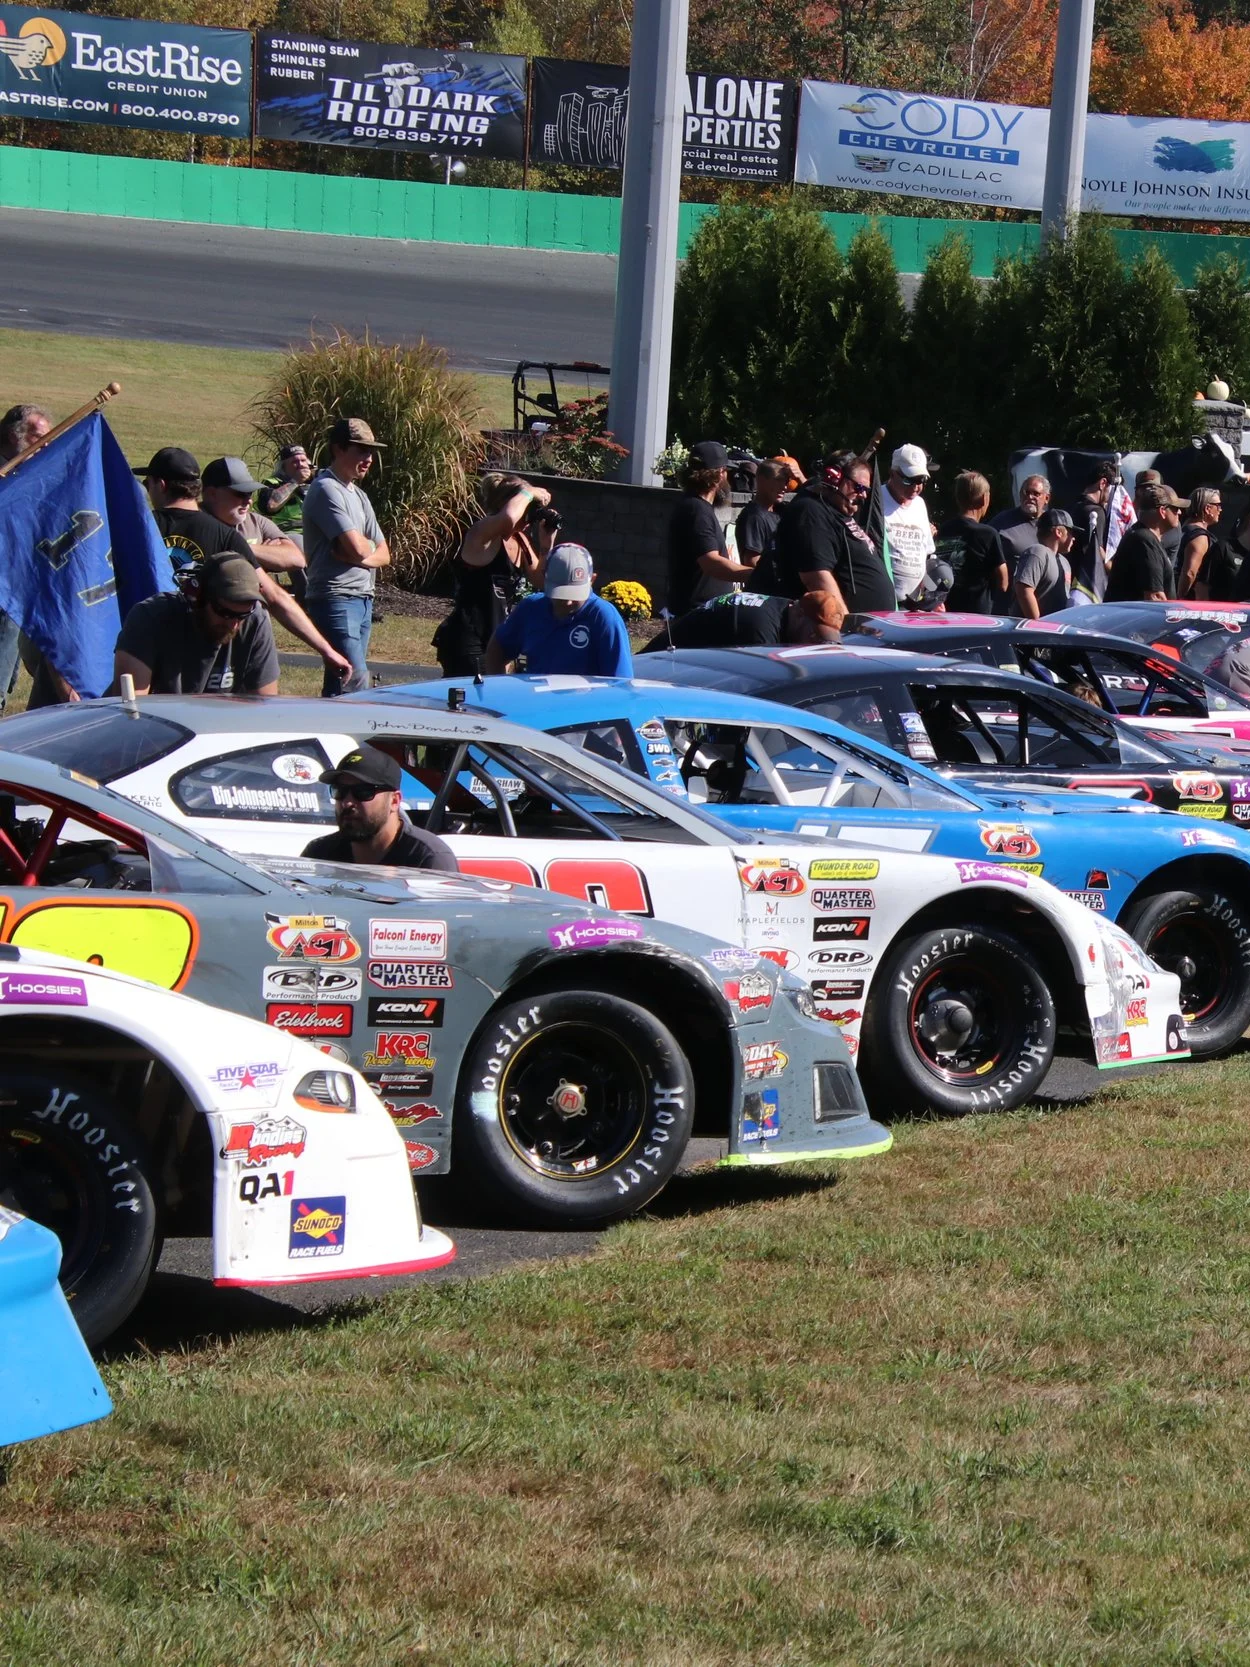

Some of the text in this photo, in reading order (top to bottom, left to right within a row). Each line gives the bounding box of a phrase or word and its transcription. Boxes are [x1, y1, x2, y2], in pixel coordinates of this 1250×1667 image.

[271, 39, 360, 58] STANDING SEAM
[71, 31, 242, 86] EastRise
[271, 53, 326, 68] SHINGLES
[270, 67, 315, 81] RUBBER
[107, 80, 208, 99] CREDIT UNION
[407, 85, 500, 114] DARK
[121, 104, 240, 126] 800.400.8790
[327, 100, 491, 135] ROOFING
[857, 92, 1026, 147] CODY
[353, 126, 483, 148] 802-839-7171
[849, 134, 1012, 163] CHEVROLET
[714, 151, 738, 161] real
[741, 155, 779, 165] estate
[684, 161, 779, 177] & development
[898, 161, 1003, 184] CADILLAC
[836, 173, 1013, 203] www.codychevrolet.com
[1132, 180, 1211, 199] JOHNSON
[1124, 200, 1142, 208] Our
[1143, 201, 1171, 211] people
[1173, 202, 1195, 211] make
[1199, 204, 1212, 213] the
[895, 529, 921, 540] BEER
[647, 743, 670, 754] 3WD
[211, 785, 320, 813] BigJohnsonStrong
[1180, 806, 1208, 814] THUNDER
[813, 862, 875, 871] THUNDER ROAD
[813, 891, 871, 903] QUARTER
[823, 899, 873, 909] MASTER
[294, 919, 319, 927] Milton
[737, 917, 806, 925] MAPLEFIELDS
[373, 928, 443, 945] Falconi Energy
[575, 926, 638, 939] HOOSIER
[817, 951, 865, 964] DRP
[369, 963, 446, 979] QUARTER
[897, 932, 974, 1001] Hoosier
[384, 973, 450, 987] MASTER
[8, 982, 83, 998] HOOSIER
[320, 992, 358, 1001] Products
[376, 1003, 428, 1013] KONI
[273, 1011, 344, 1028] Edelbrock
[376, 1032, 431, 1059] KRC
[402, 1057, 436, 1069] teering
[217, 1063, 279, 1082] FIVE STAR
[614, 1082, 687, 1197] Hoosier
[33, 1087, 144, 1214] Hoosier
[239, 1170, 295, 1205] QA1
[295, 1216, 342, 1232] SUNOCO
[290, 1244, 343, 1258] RACE FUELS
